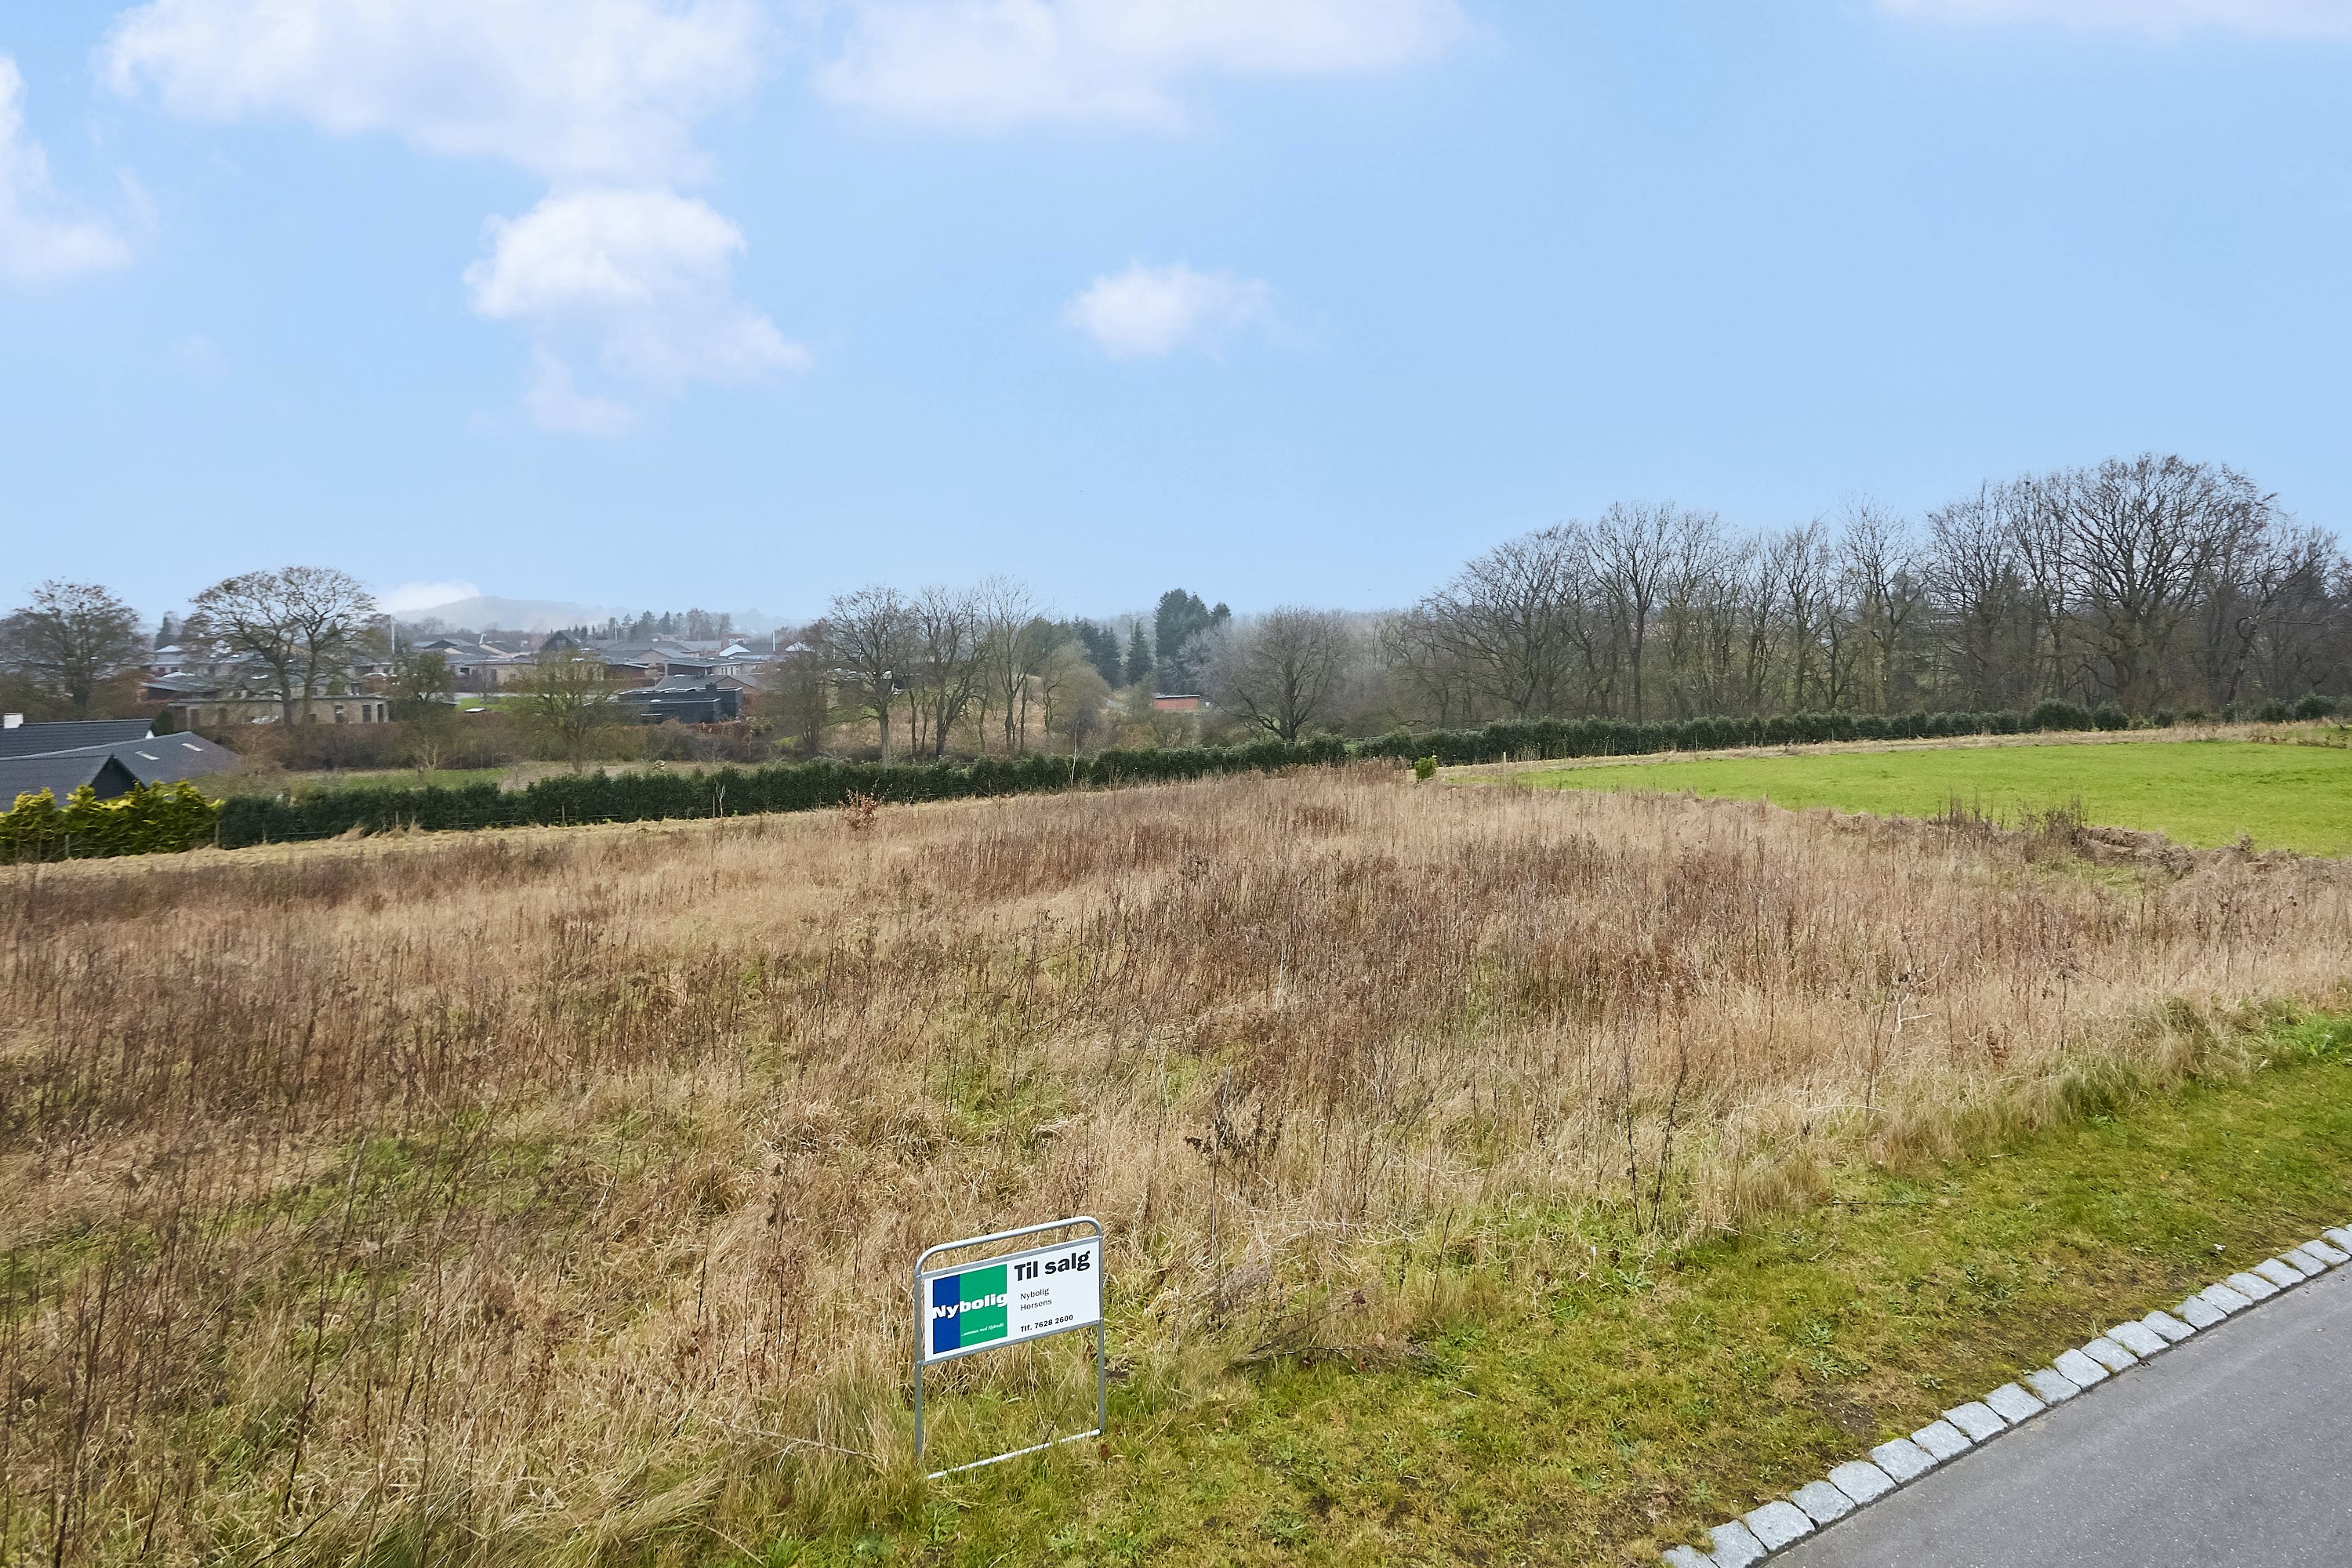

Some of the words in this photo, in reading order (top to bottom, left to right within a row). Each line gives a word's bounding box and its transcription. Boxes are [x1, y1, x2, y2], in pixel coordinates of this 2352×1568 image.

[1014, 1261, 1038, 1281] Til
[1044, 1250, 1091, 1274] salg
[1021, 1288, 1049, 1300] Nybolig
[932, 1293, 1007, 1319] Nybolig
[1021, 1299, 1052, 1311] Horsens
[1021, 1323, 1033, 1332] Tlf.
[1035, 1319, 1053, 1329] 7628
[1054, 1314, 1073, 1323] 2600
